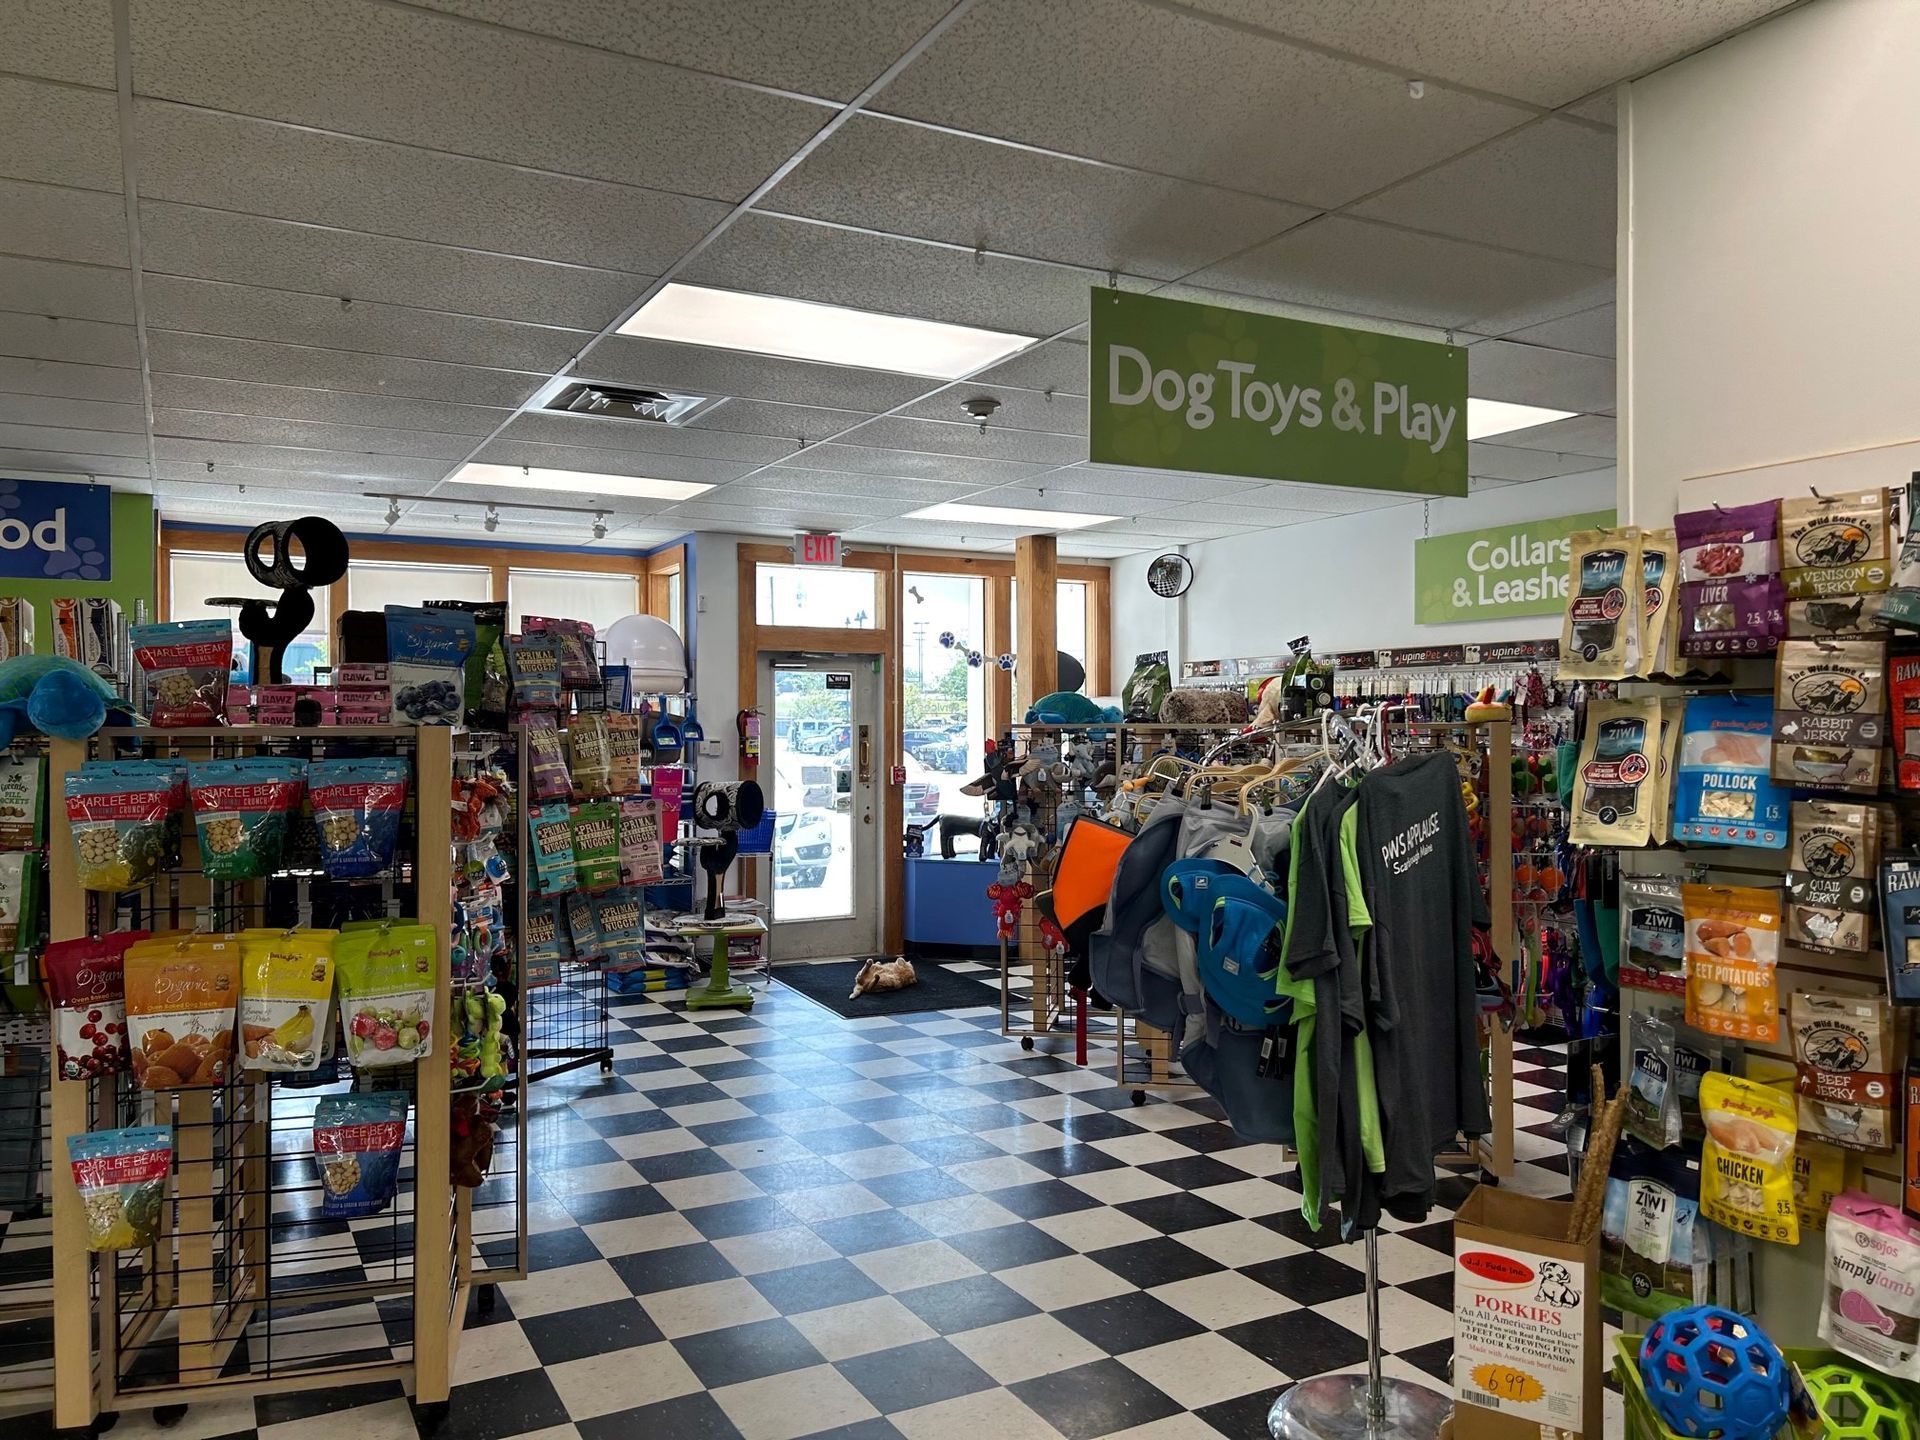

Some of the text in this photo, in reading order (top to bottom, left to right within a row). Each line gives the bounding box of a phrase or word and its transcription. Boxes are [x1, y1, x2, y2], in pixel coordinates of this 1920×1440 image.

[1109, 344, 1456, 454] Dog Toys & Play
[0, 508, 65, 553] od
[1790, 515, 1872, 540] The Wild Bone Co.
[804, 535, 836, 562] EXIT
[1467, 533, 1570, 572] Collars
[1592, 559, 1618, 573] ZIWI
[1803, 567, 1866, 582] VENISON
[1452, 577, 1473, 607] &
[1700, 586, 1728, 603] LIVER
[1814, 580, 1857, 594] JERKY
[141, 643, 226, 660] CHARLEE BEAR
[521, 651, 553, 660] PRIMAL
[521, 664, 556, 672] NUGGETS
[1787, 664, 1871, 685] The Wild Bone Co.
[262, 695, 292, 704] RAWZ
[342, 694, 372, 702] RAWZ
[262, 716, 293, 725] RAWZ
[345, 716, 375, 725] RAWZ
[1801, 717, 1853, 730] RABBIT
[1609, 727, 1636, 739] ZIWI
[1804, 729, 1847, 742] JERKY
[1703, 774, 1758, 790] POLLOCK
[198, 784, 282, 799] CHARLEE BEAR
[314, 786, 363, 800] CHARLEE
[69, 792, 161, 809] CHARLEE BEAR
[244, 797, 268, 805] CRUNCH
[120, 805, 145, 814] CRUNCH
[1766, 807, 1778, 818] 1.5
[542, 823, 570, 837] PRIMAL
[580, 820, 610, 834] PRIMAL
[581, 835, 615, 850] NUGGETS
[1799, 832, 1811, 844] The
[1812, 827, 1826, 835] Wild
[1844, 835, 1856, 849] Co.
[1810, 879, 1841, 893] QUAIL
[1806, 891, 1840, 904] JERKY
[605, 904, 638, 918] PRIMAL
[1645, 914, 1673, 928] ZIWI
[1716, 966, 1770, 988] POTATOES
[155, 977, 209, 1003] Organic
[1799, 1020, 1869, 1045] The Wild Bone Co.
[1643, 1056, 1660, 1075] ZIWI
[1817, 1072, 1851, 1087] BEEF
[1815, 1086, 1856, 1100] JERKY
[369, 1123, 397, 1136] BEAR
[77, 1152, 165, 1173] CHARLEE BEAR
[123, 1166, 147, 1177] CRUNCH
[1716, 1157, 1763, 1185] CHICKEN
[1636, 1191, 1666, 1213] ZIWI
[1777, 1203, 1791, 1214] 3.5
[1870, 1239, 1898, 1257] sojos
[1510, 1268, 1526, 1277] Inc.
[1833, 1255, 1915, 1297] simplylamb
[1475, 1294, 1562, 1326] PORKIES
[1477, 1310, 1490, 1320] All
[1492, 1314, 1537, 1333] American
[1459, 1316, 1579, 1350] Tasty and Fun with Real Bacon Flavor
[1461, 1332, 1575, 1365] FOR YOUR K-9 COMPANION
[1472, 1327, 1493, 1337] FEET
[1495, 1331, 1507, 1340] OF
[1509, 1335, 1550, 1351] CHEWING
[1553, 1346, 1571, 1355] FUN
[1469, 1344, 1487, 1353] Made
[1489, 1349, 1502, 1357] with
[1504, 1352, 1535, 1366] American
[1536, 1360, 1551, 1369] beef
